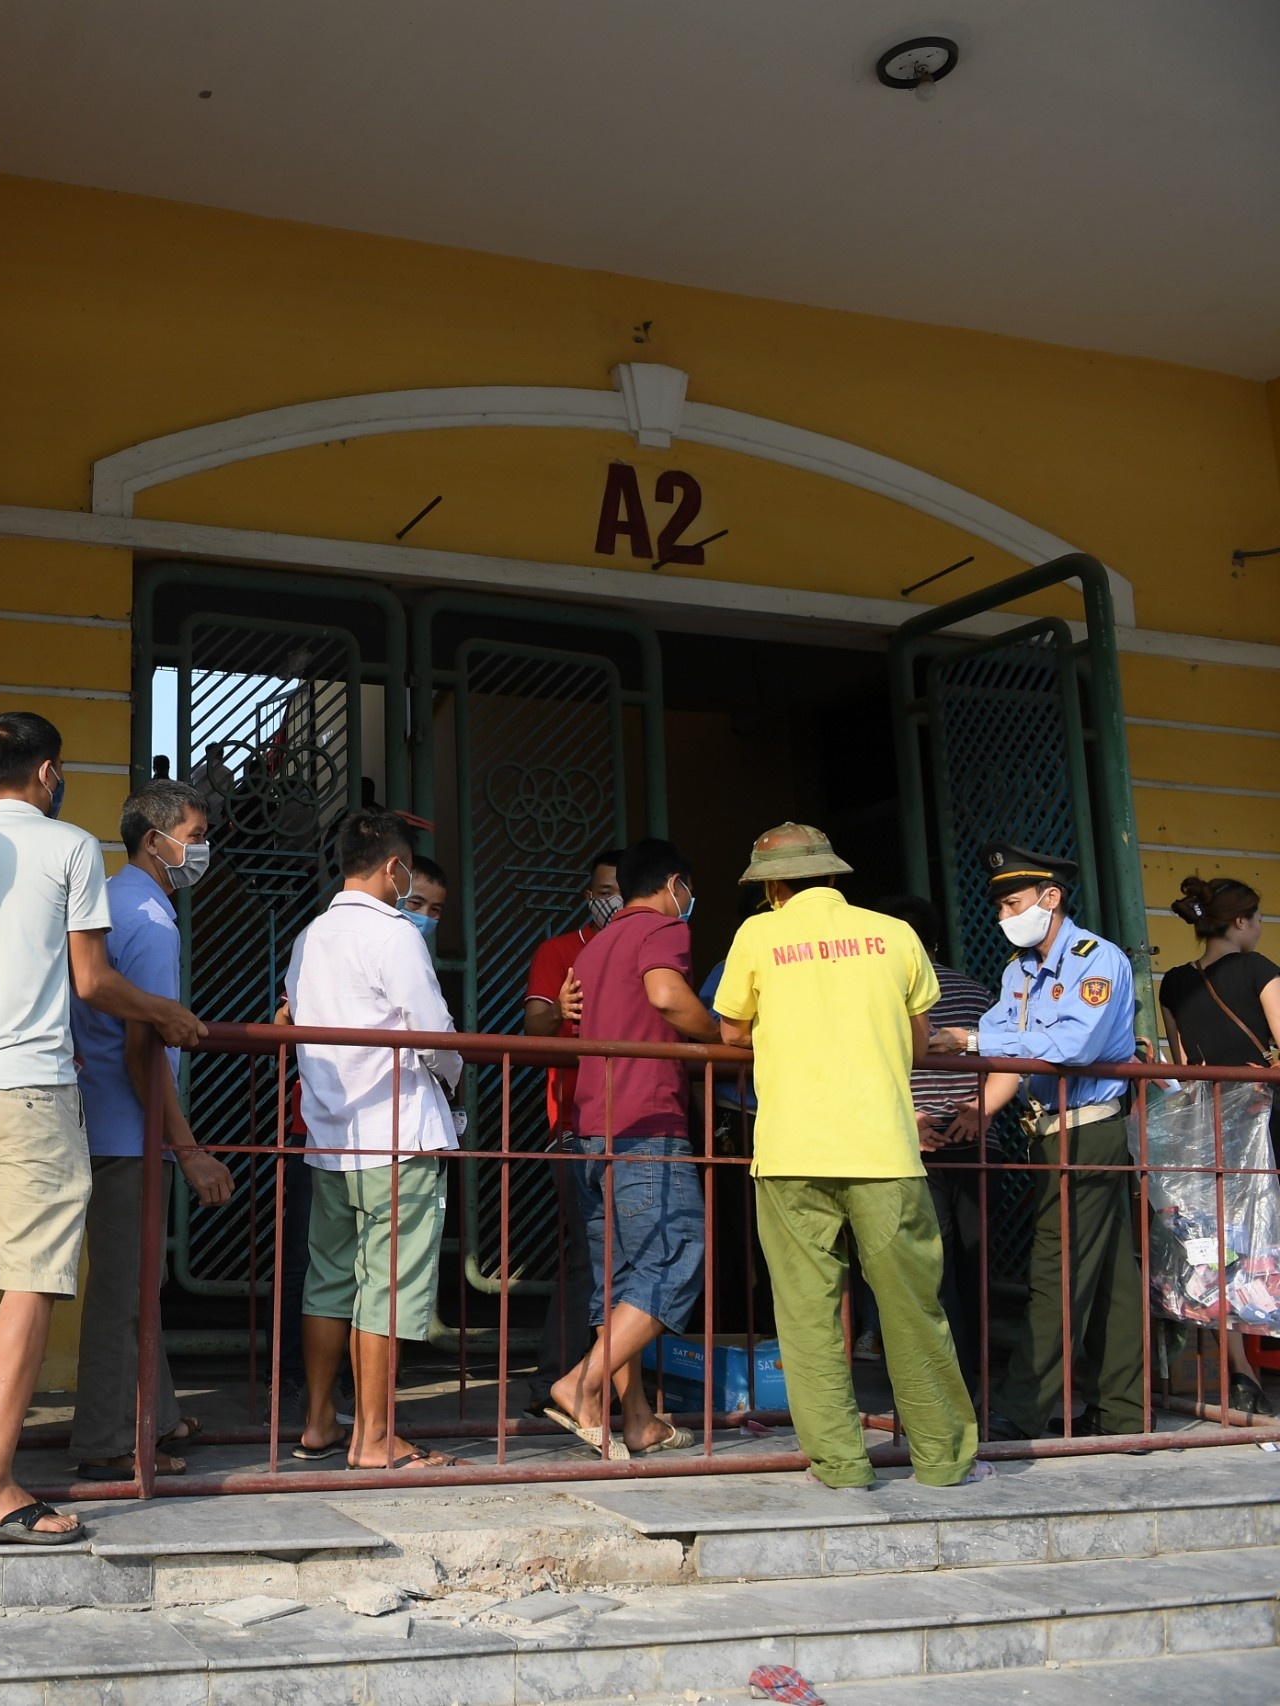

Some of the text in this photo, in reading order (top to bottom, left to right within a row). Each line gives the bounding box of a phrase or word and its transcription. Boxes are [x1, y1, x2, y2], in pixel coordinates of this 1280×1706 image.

[594, 464, 704, 565] A2
[773, 937, 886, 966] NAM ĐỊNH FC
